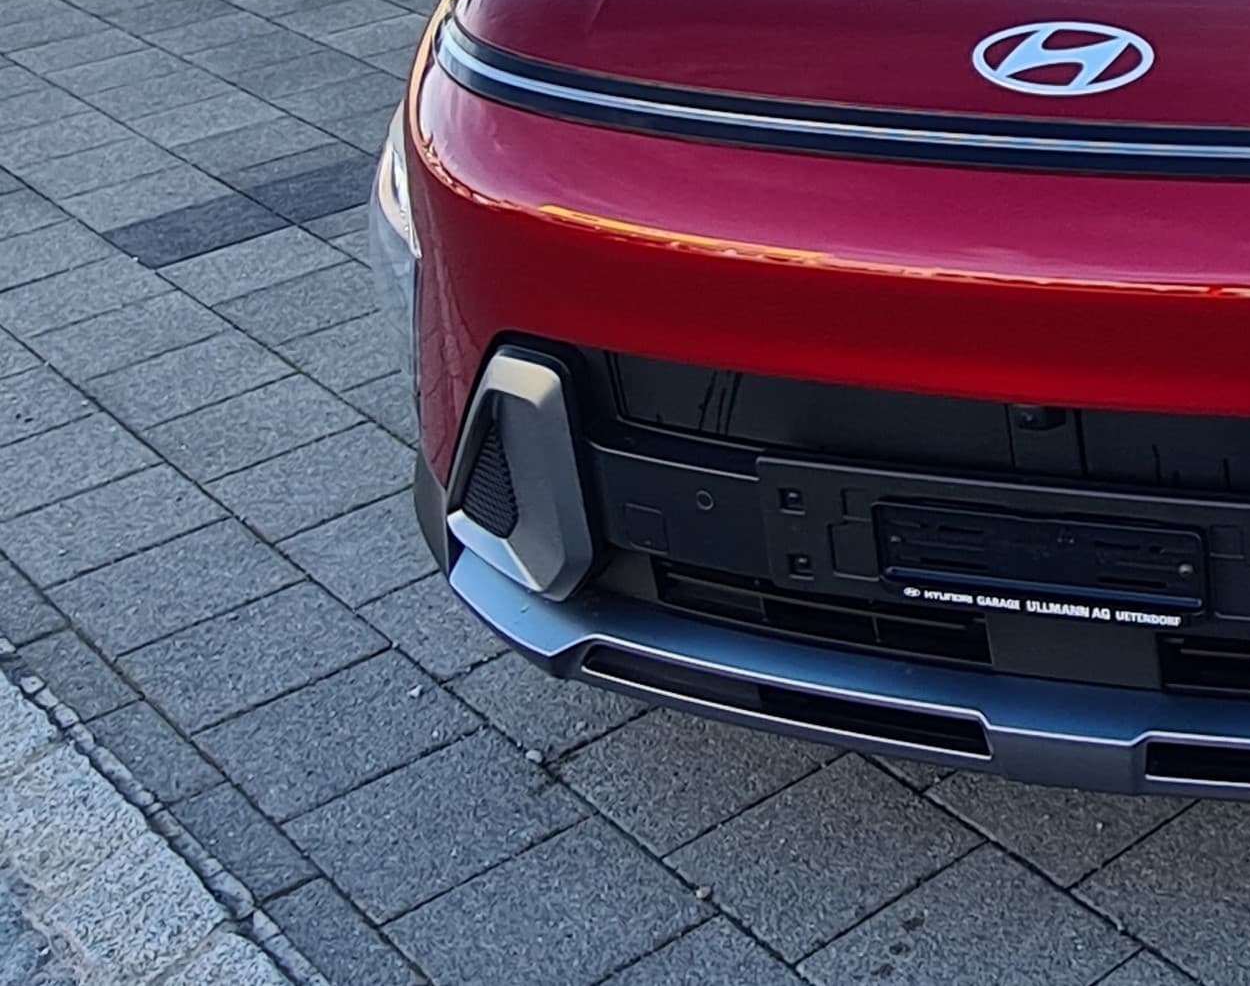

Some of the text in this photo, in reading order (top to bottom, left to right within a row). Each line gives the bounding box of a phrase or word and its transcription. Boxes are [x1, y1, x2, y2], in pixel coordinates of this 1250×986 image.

[976, 595, 1021, 611] GARAGE
[1026, 599, 1090, 618] ULLMANN
[1091, 606, 1111, 620] AG
[1115, 610, 1181, 627] UETENDORF
